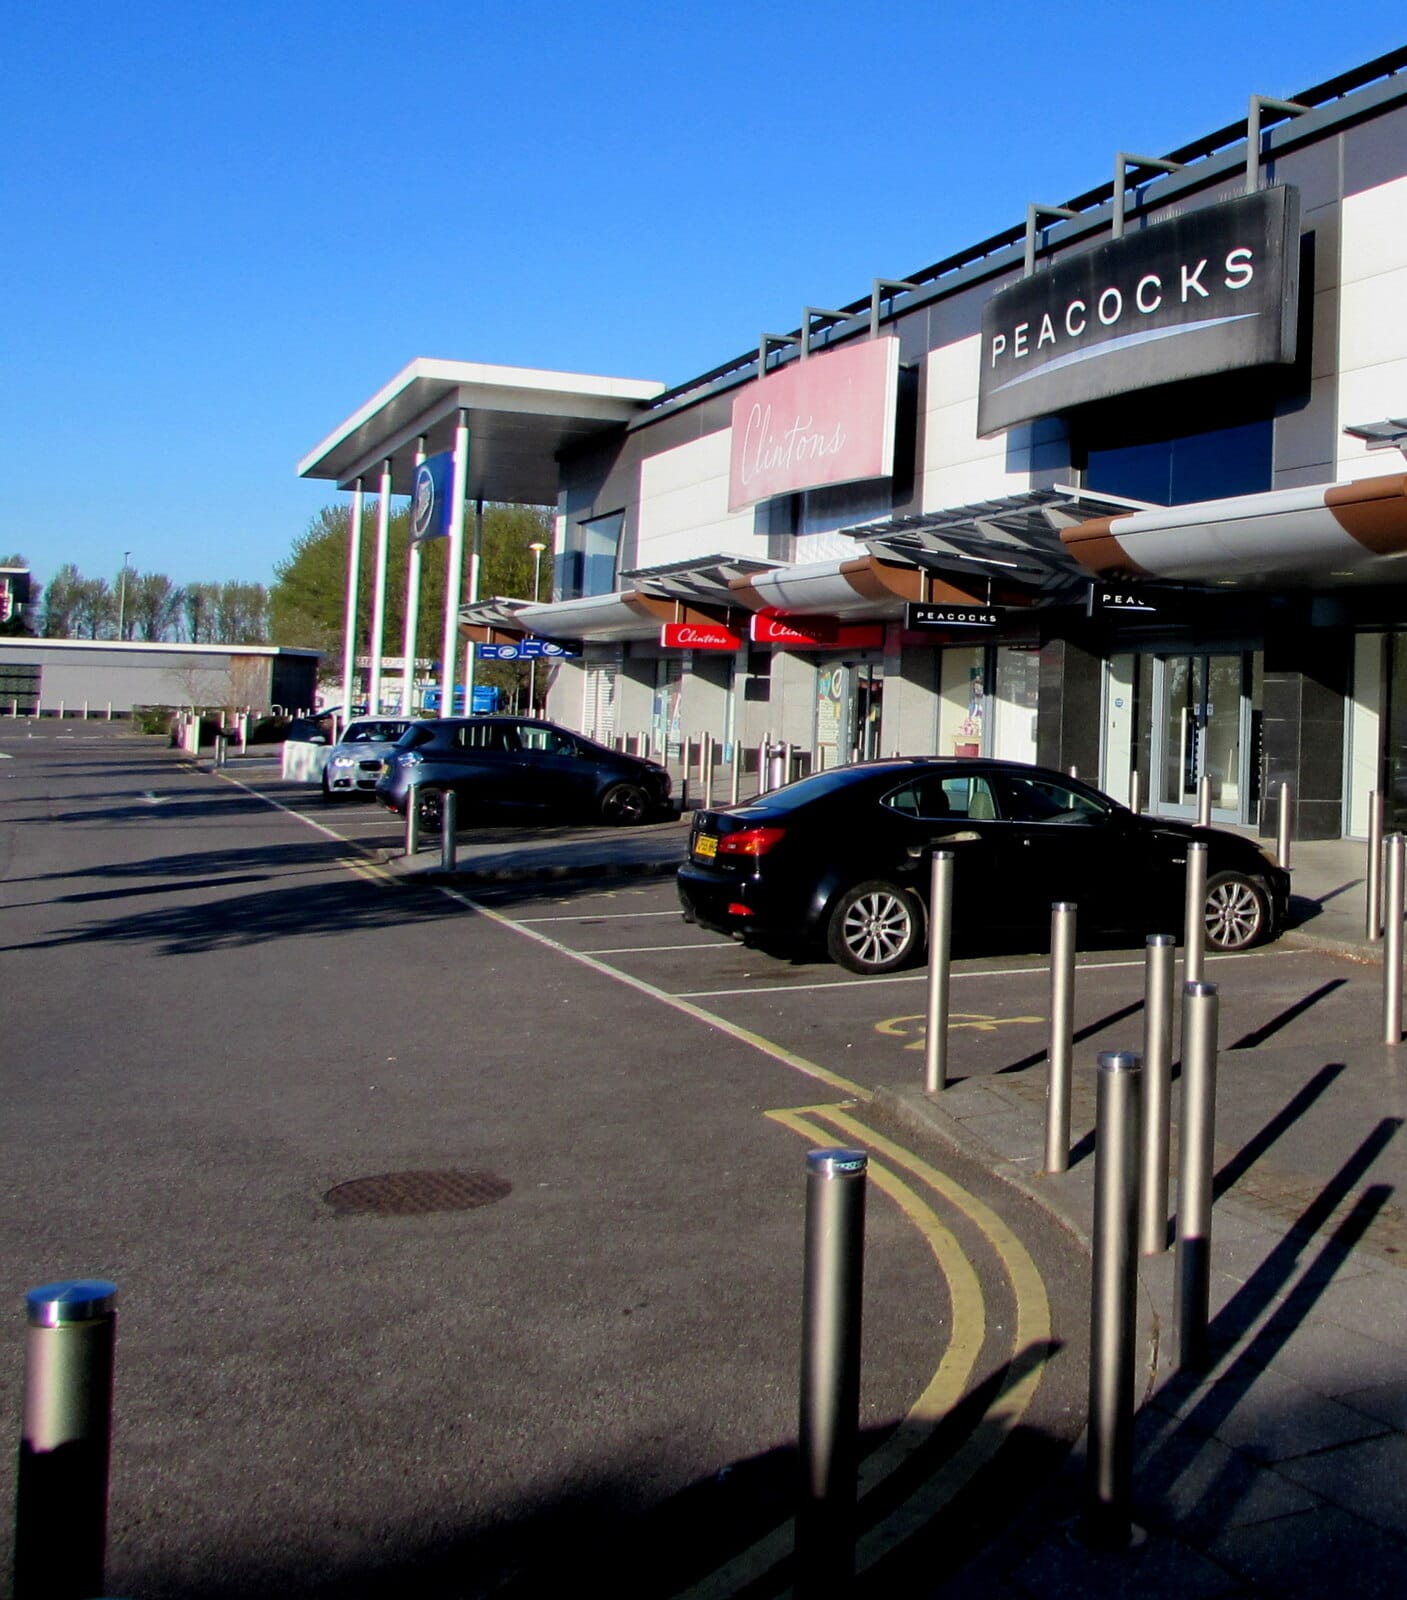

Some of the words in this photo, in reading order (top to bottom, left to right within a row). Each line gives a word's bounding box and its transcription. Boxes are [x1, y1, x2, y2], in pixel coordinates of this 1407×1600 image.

[991, 247, 1254, 369] PEACOCKS
[741, 402, 847, 486] Clintons
[677, 628, 727, 644] Clintons
[916, 610, 998, 623] PEACOCKS
